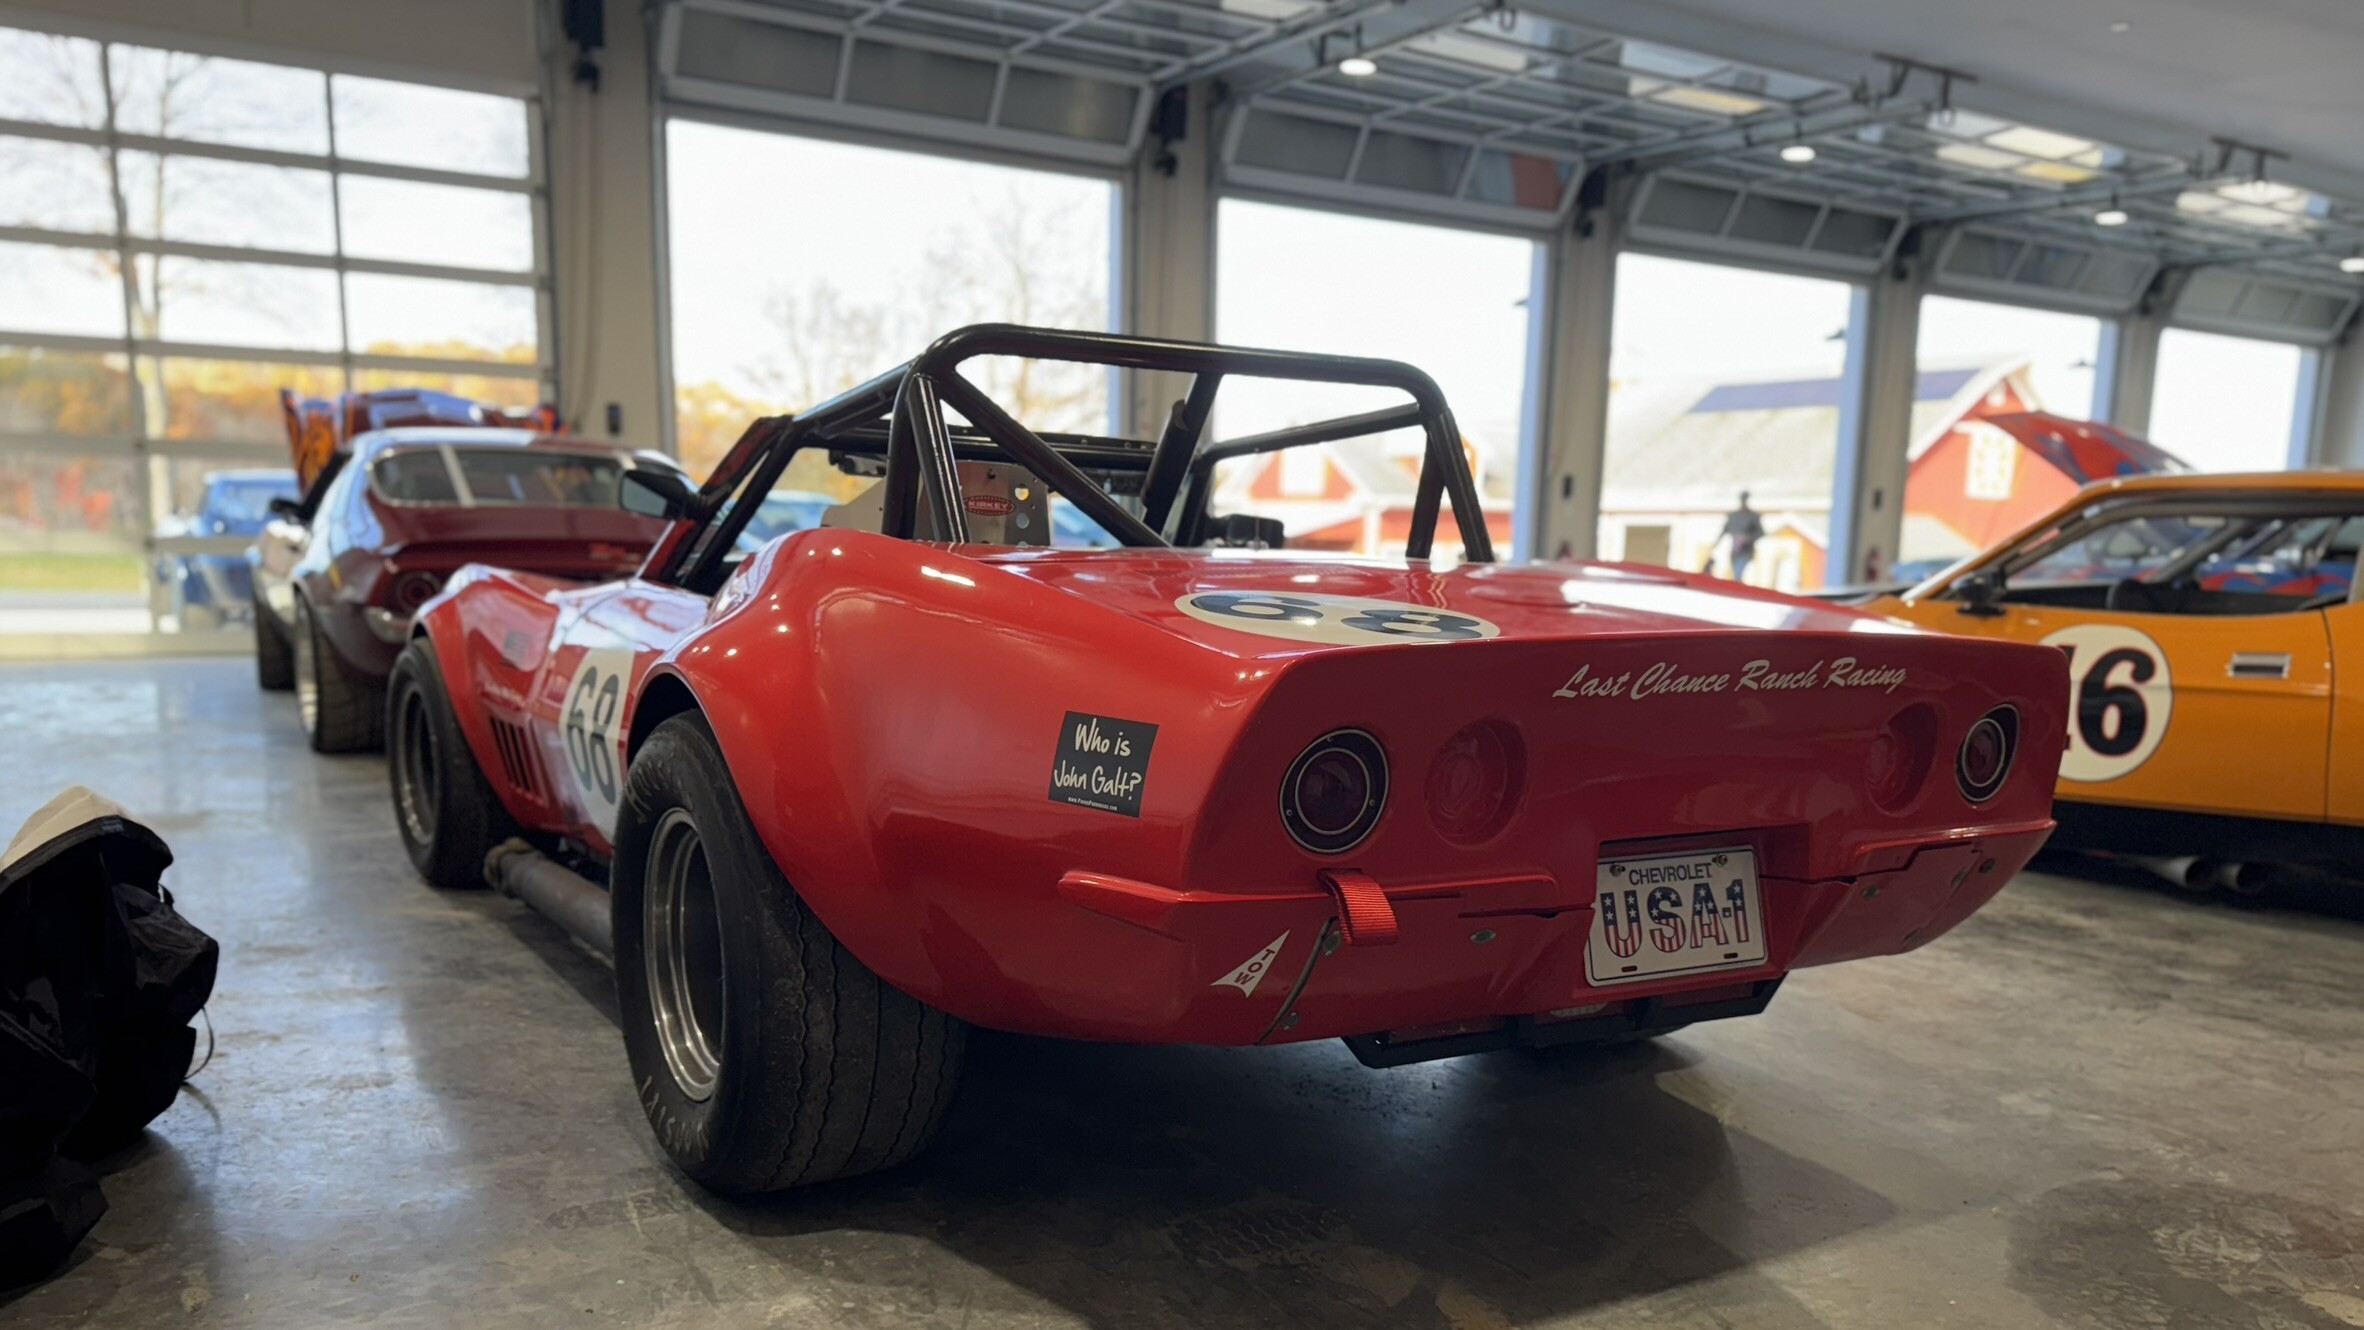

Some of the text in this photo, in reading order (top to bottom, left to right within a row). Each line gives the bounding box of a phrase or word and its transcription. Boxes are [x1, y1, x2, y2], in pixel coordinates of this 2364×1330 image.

[968, 501, 1009, 510] KIRKEY
[1190, 594, 1483, 640] 68
[1552, 657, 1907, 700] Last Chance Ranch Racing
[2058, 645, 2156, 757] 6
[567, 666, 620, 805] 68
[1075, 718, 1131, 757] Who is
[1054, 760, 1142, 800] John Galt?
[1628, 862, 1713, 886] CHEVROLET
[1600, 878, 1749, 959] USA-1
[1234, 948, 1276, 985] TOW
